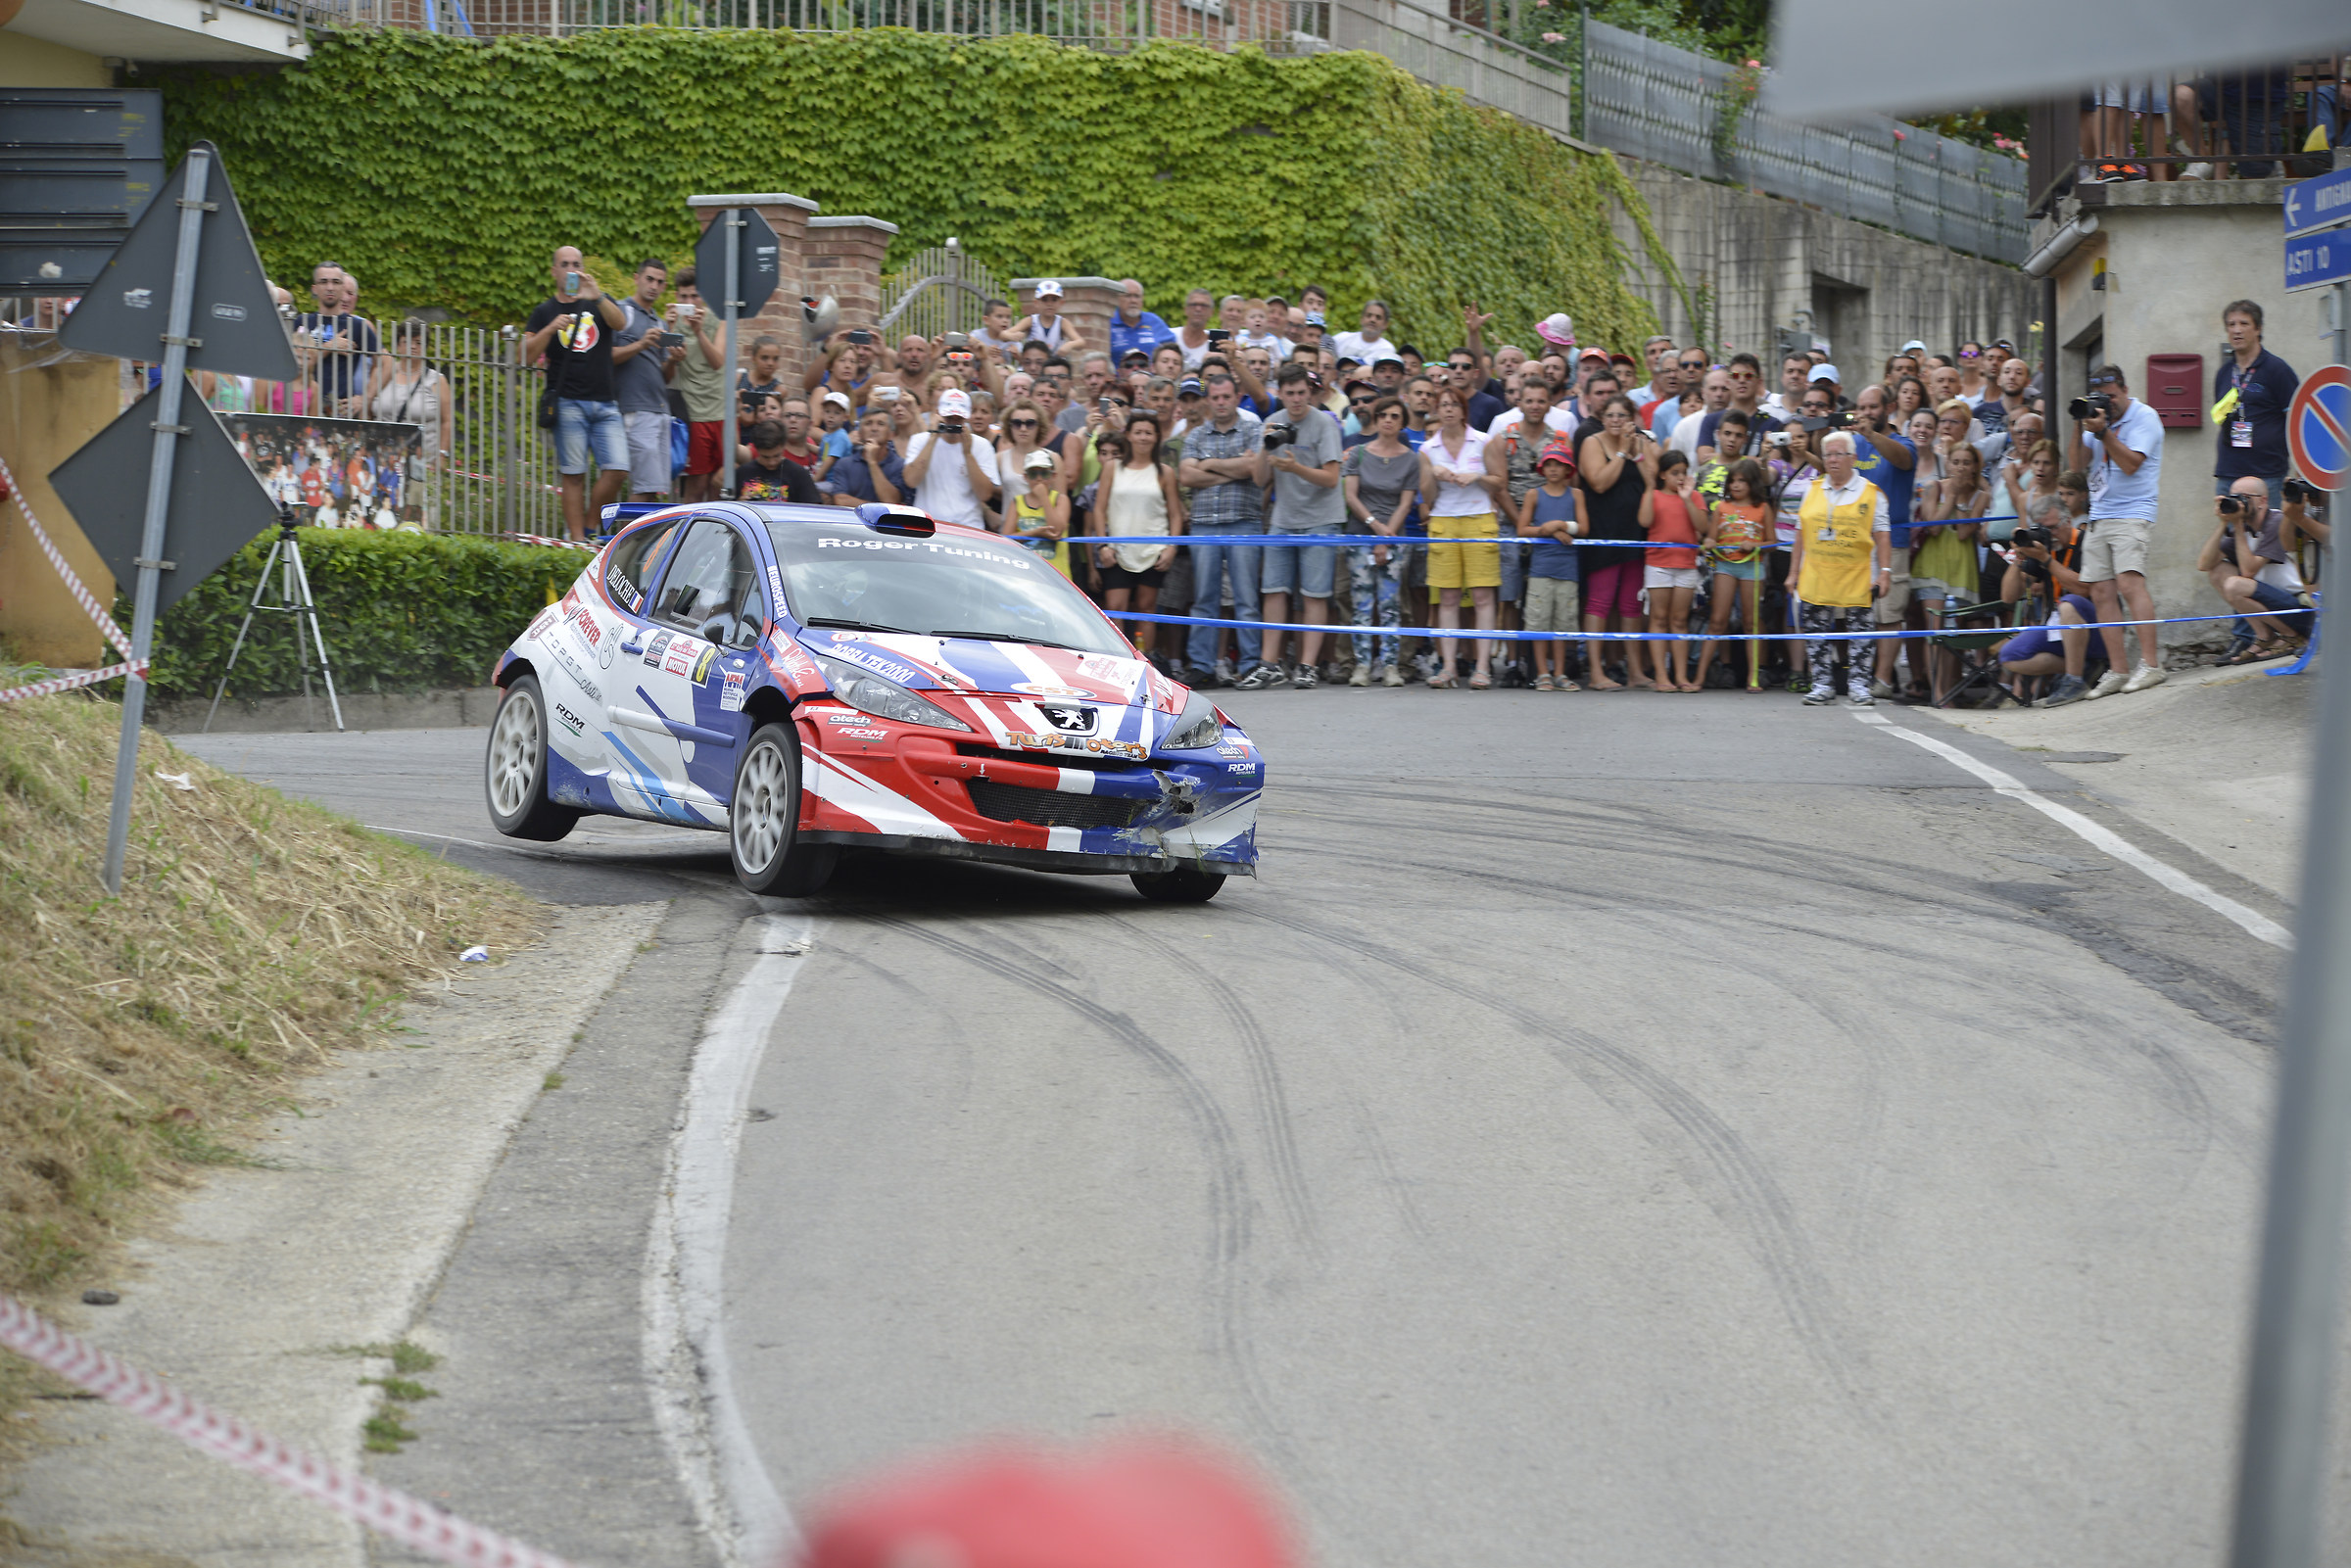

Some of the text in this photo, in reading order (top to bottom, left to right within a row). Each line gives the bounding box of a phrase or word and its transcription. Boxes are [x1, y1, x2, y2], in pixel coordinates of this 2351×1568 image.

[2285, 245, 2330, 275] ASTI 10
[818, 538, 1031, 571] Roger Tuning
[606, 564, 636, 604] DELOCHE
[576, 608, 601, 647] FOREVER
[666, 657, 688, 675] MOTUL
[696, 647, 716, 683] 8
[1026, 686, 1079, 696] CST
[554, 702, 585, 731] RDM
[830, 714, 872, 723] atech
[837, 727, 889, 737] RDM
[1226, 763, 1256, 773] RDM
